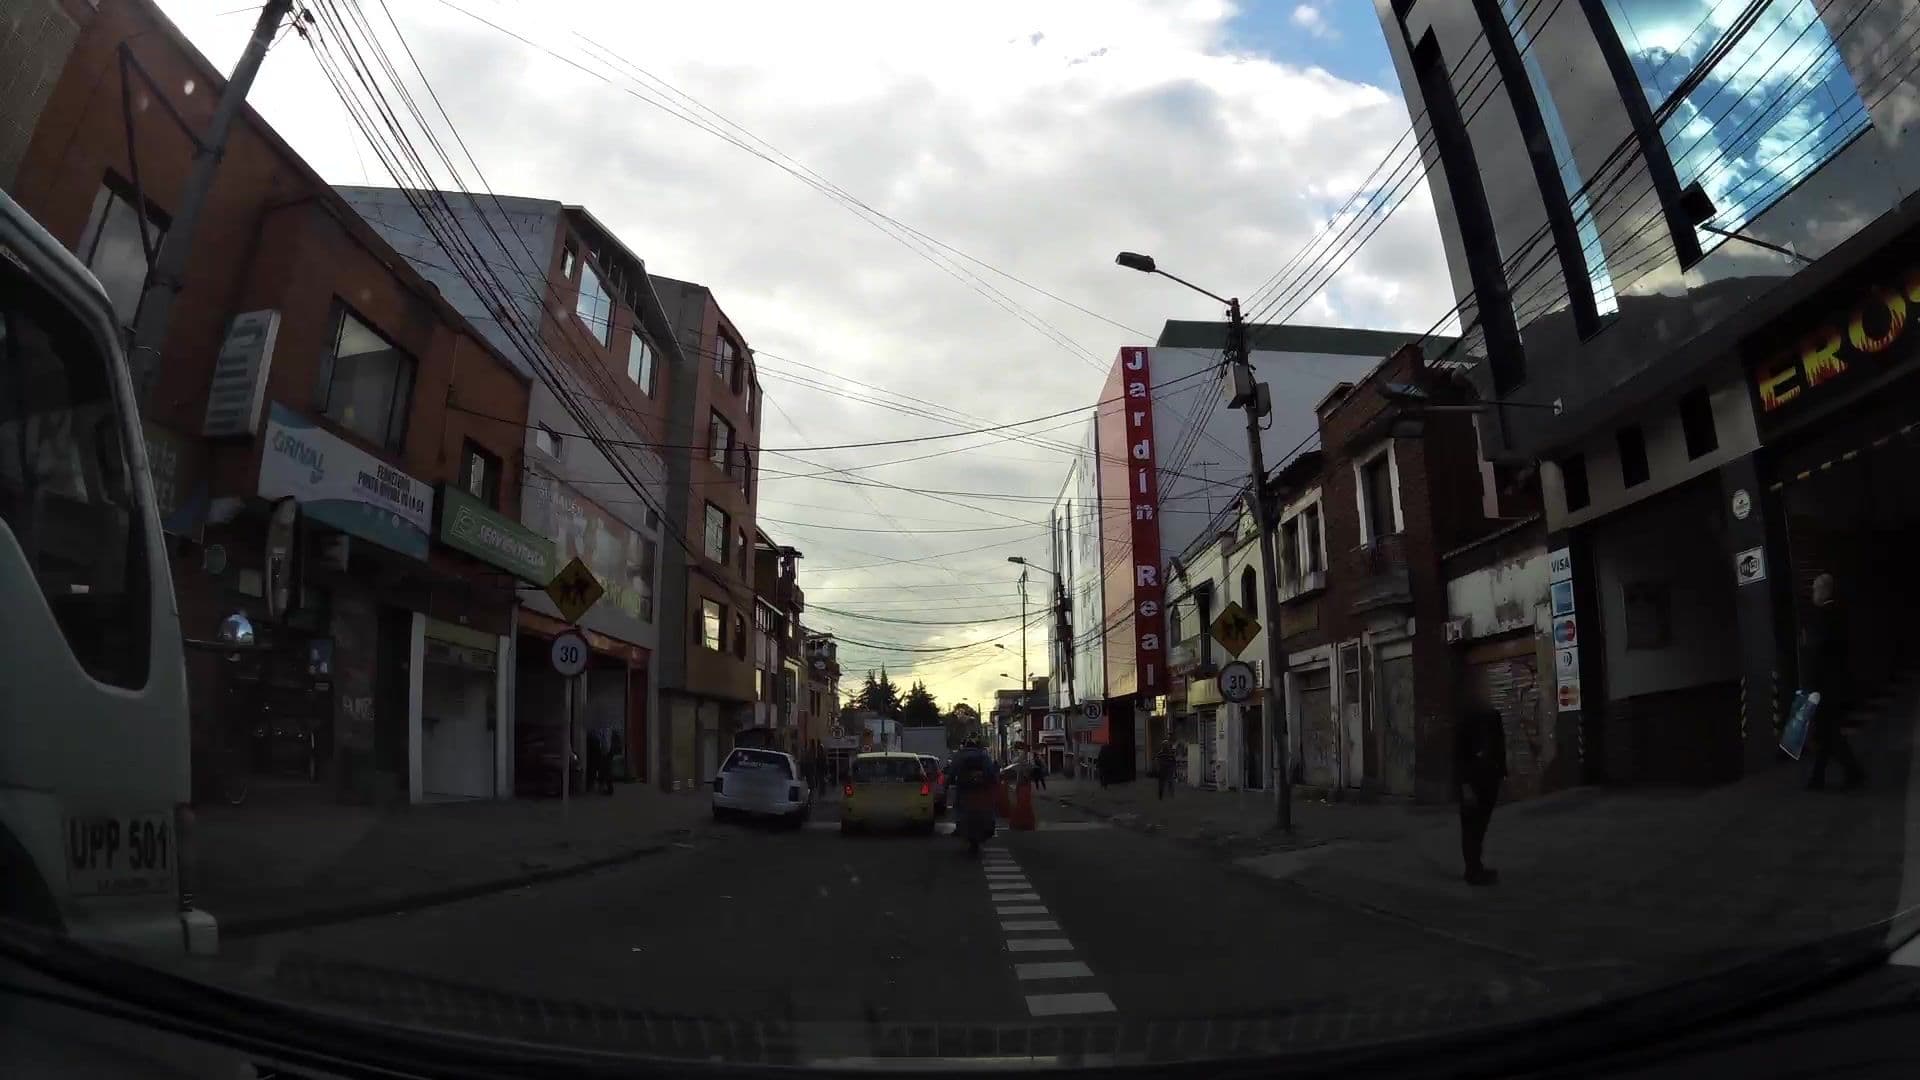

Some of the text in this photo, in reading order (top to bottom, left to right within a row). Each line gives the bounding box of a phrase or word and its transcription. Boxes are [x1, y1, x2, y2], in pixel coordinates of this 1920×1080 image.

[1551, 557, 1570, 573] VISA
[1137, 565, 1161, 686] Real
[560, 646, 578, 664] 30
[1230, 675, 1246, 690] 30
[70, 819, 168, 871] UPP 501
